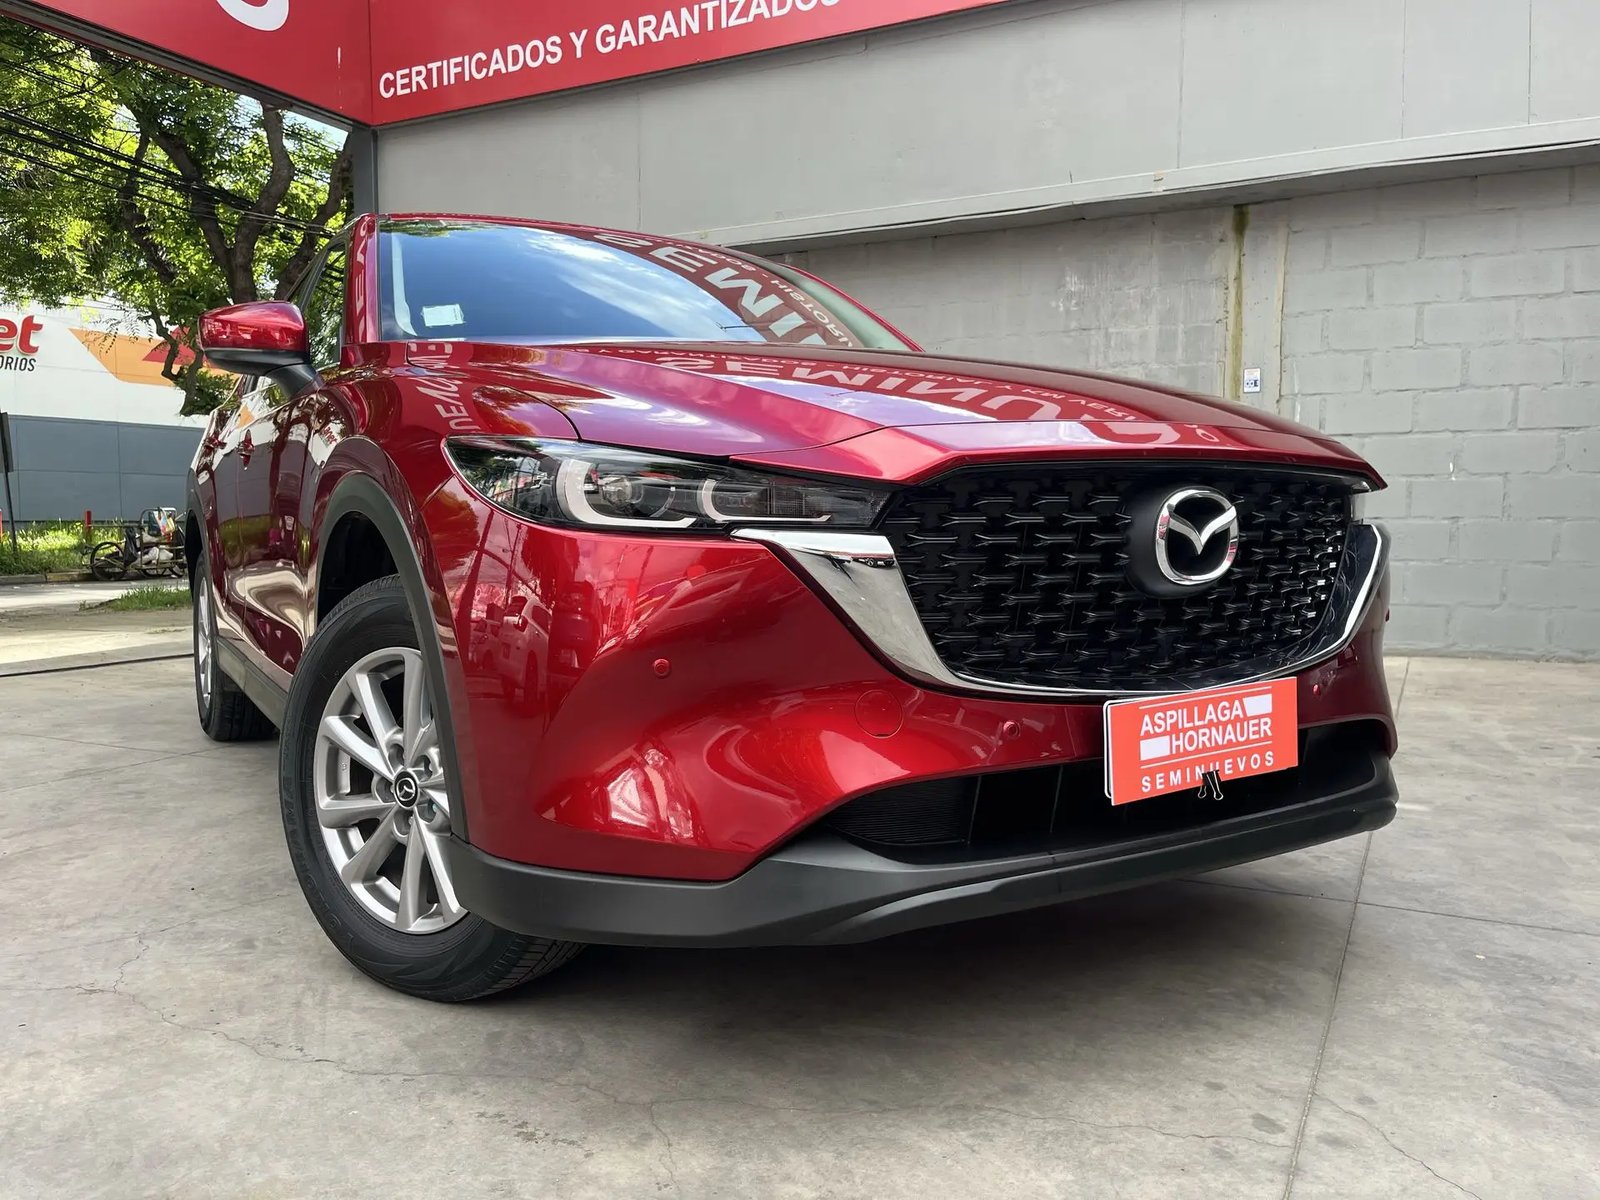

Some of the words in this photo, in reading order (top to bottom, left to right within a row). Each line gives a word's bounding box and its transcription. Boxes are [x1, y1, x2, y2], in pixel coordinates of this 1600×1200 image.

[379, 36, 563, 99] CERTIFICADOS
[569, 29, 588, 58] Y
[595, 0, 839, 54] GARANTIZAD
[1140, 700, 1244, 736] ASPILLAGA
[1172, 717, 1272, 754] HORNAUER
